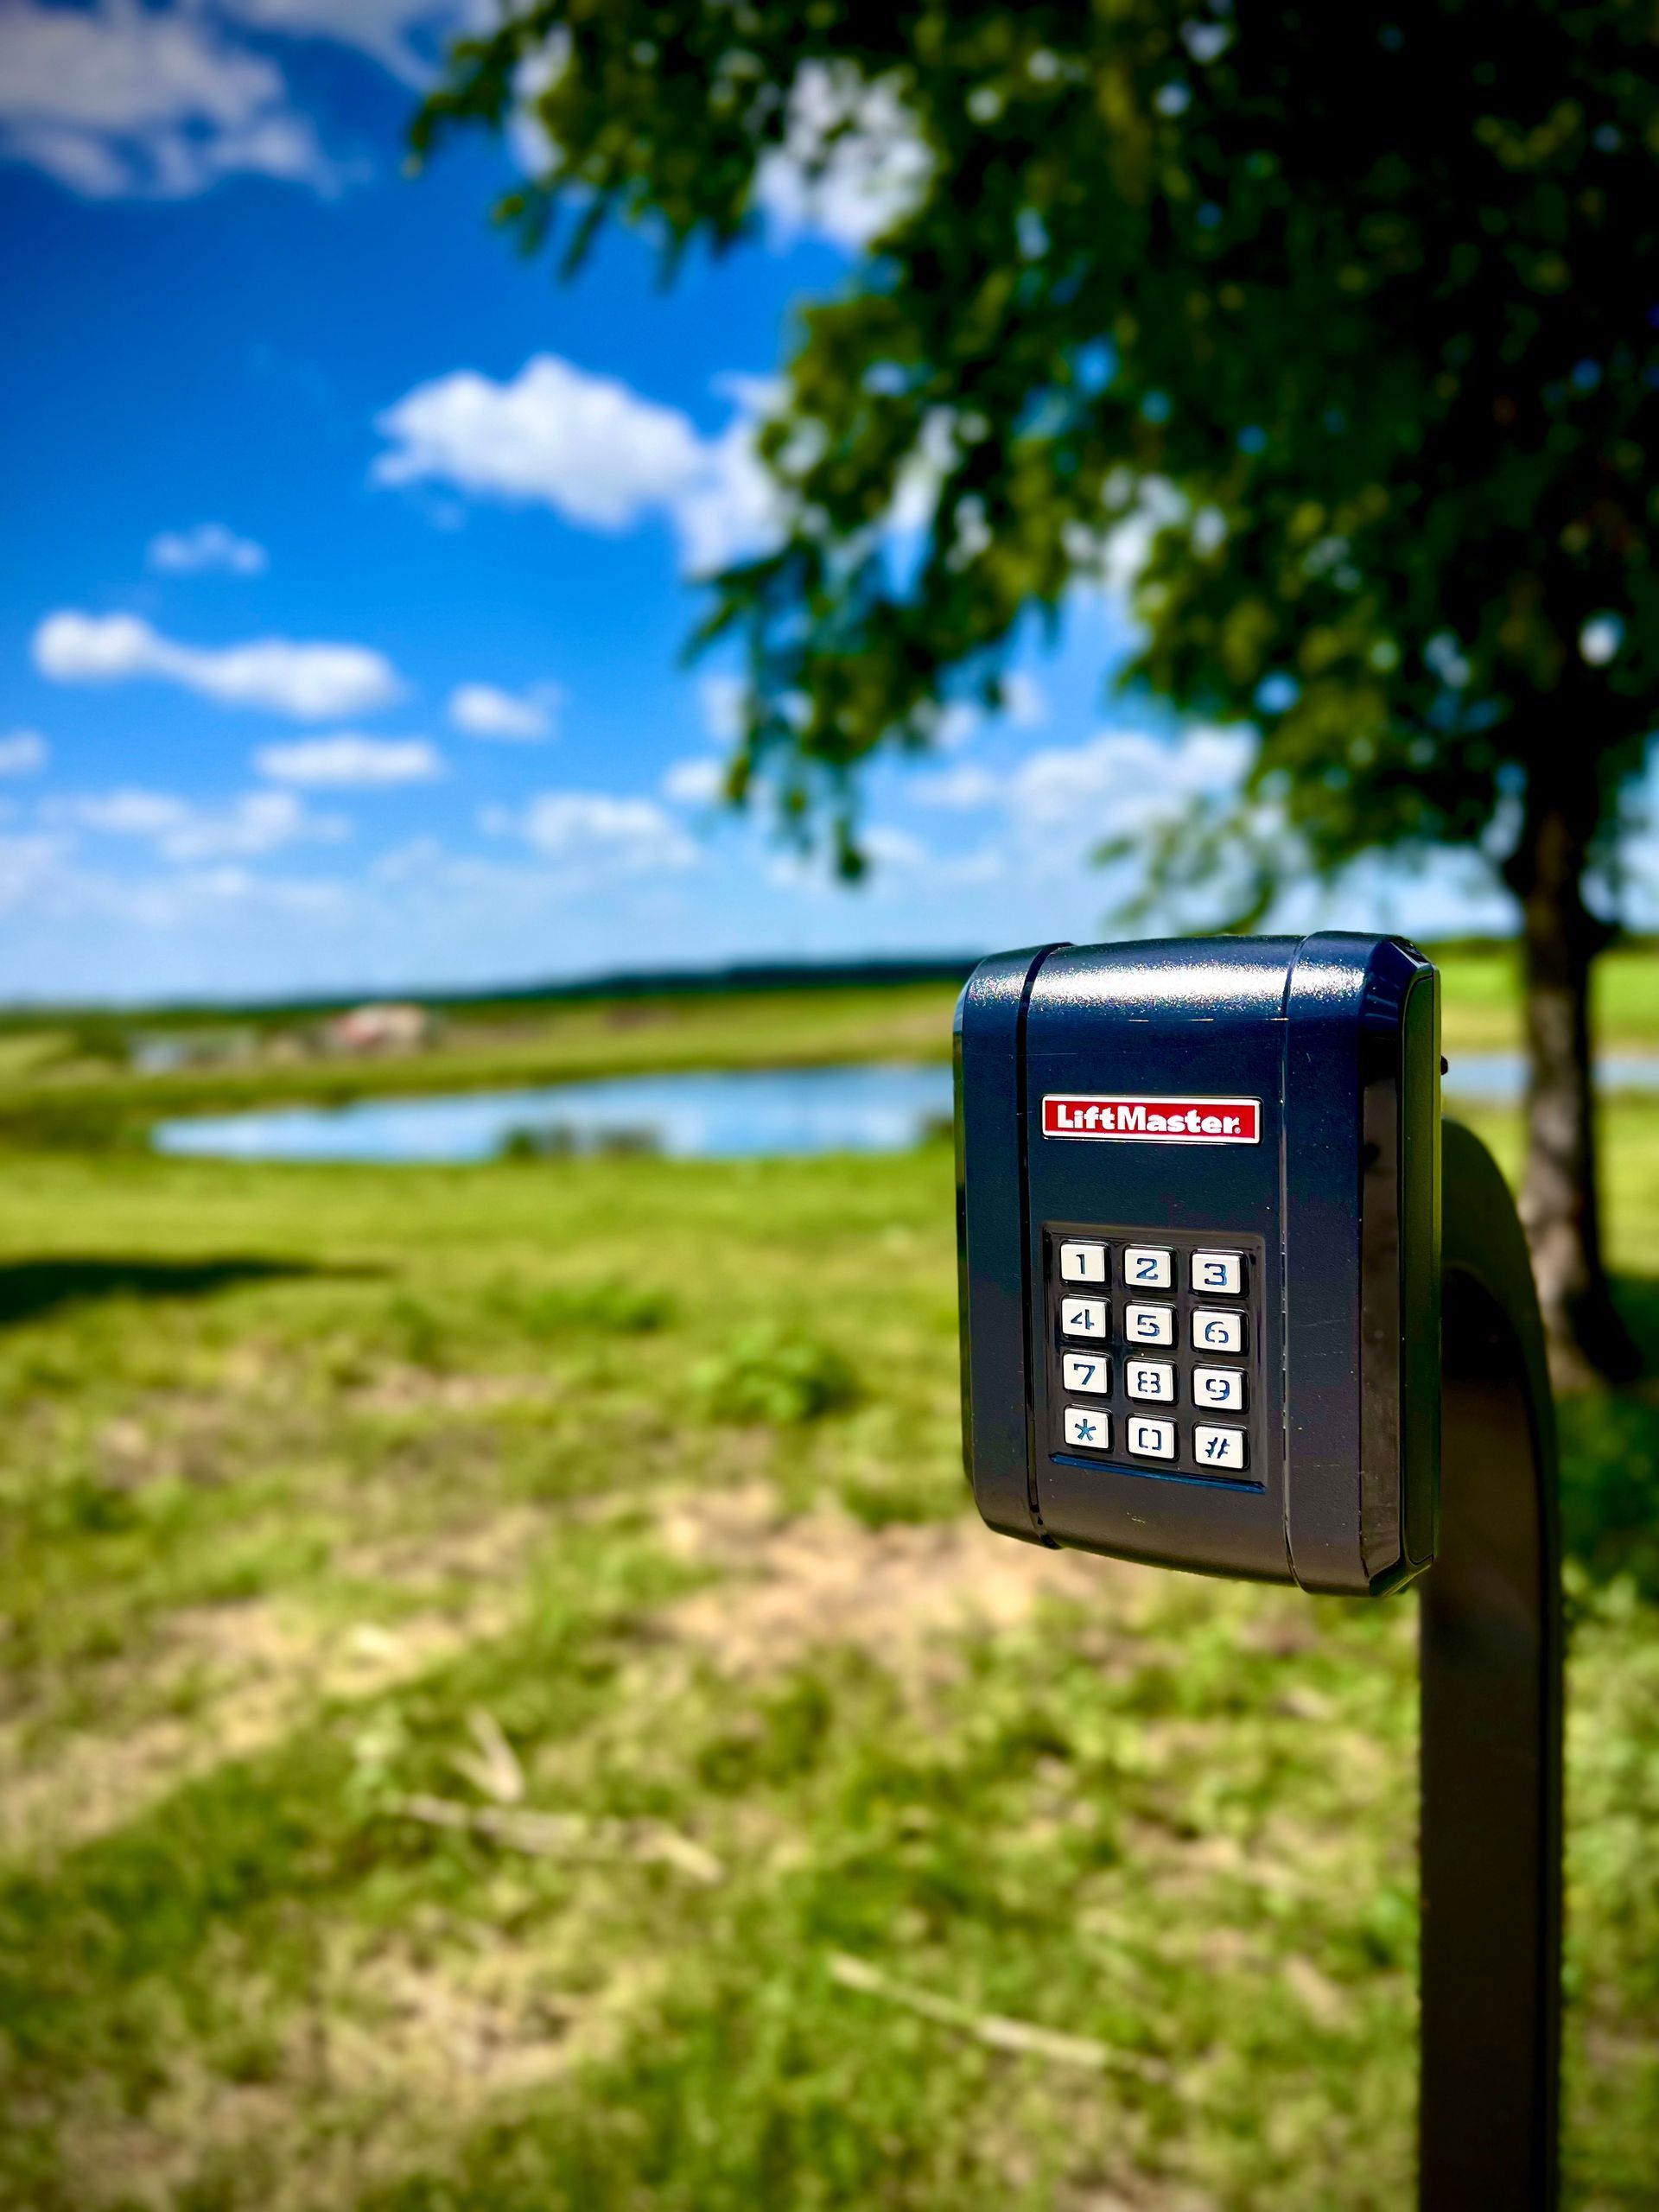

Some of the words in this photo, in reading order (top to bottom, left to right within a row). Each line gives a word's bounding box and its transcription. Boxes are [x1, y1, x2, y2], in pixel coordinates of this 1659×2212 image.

[1057, 1104, 1241, 1134] LiftMaster
[1076, 1253, 1086, 1274] 1
[1135, 1257, 1159, 1281] 2
[1204, 1262, 1228, 1287] 3
[1070, 1308, 1095, 1330] 4
[1136, 1313, 1160, 1338] 5
[1204, 1321, 1230, 1344] 6
[1072, 1363, 1096, 1385] 7
[1136, 1370, 1161, 1394] 8
[1205, 1378, 1230, 1402] 9
[1138, 1427, 1162, 1451] 0
